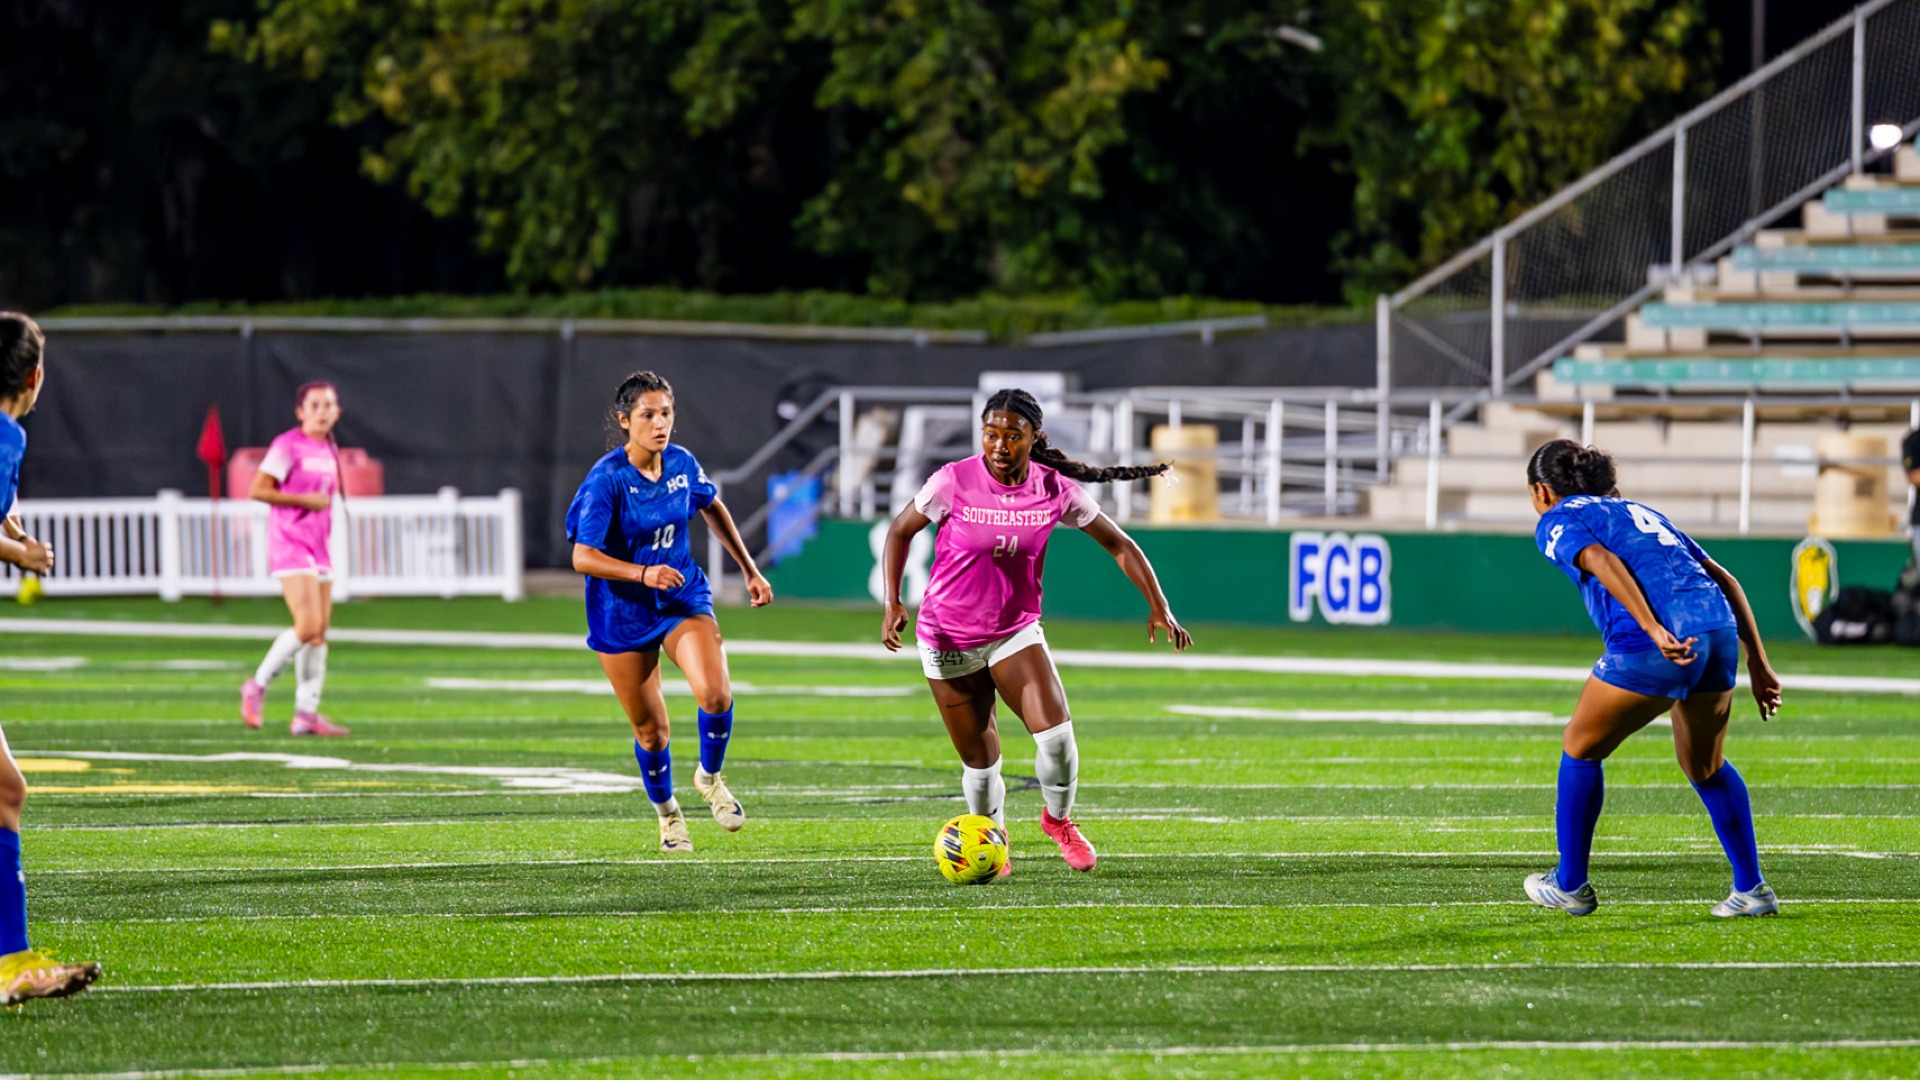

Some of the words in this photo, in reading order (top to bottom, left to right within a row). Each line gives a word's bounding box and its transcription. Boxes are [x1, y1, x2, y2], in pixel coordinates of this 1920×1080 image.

[962, 506, 1052, 526] SOUTHEASTERN
[1626, 503, 1679, 546] 4
[652, 524, 675, 550] 10
[993, 535, 1019, 557] 24
[1293, 538, 1387, 618] FGB
